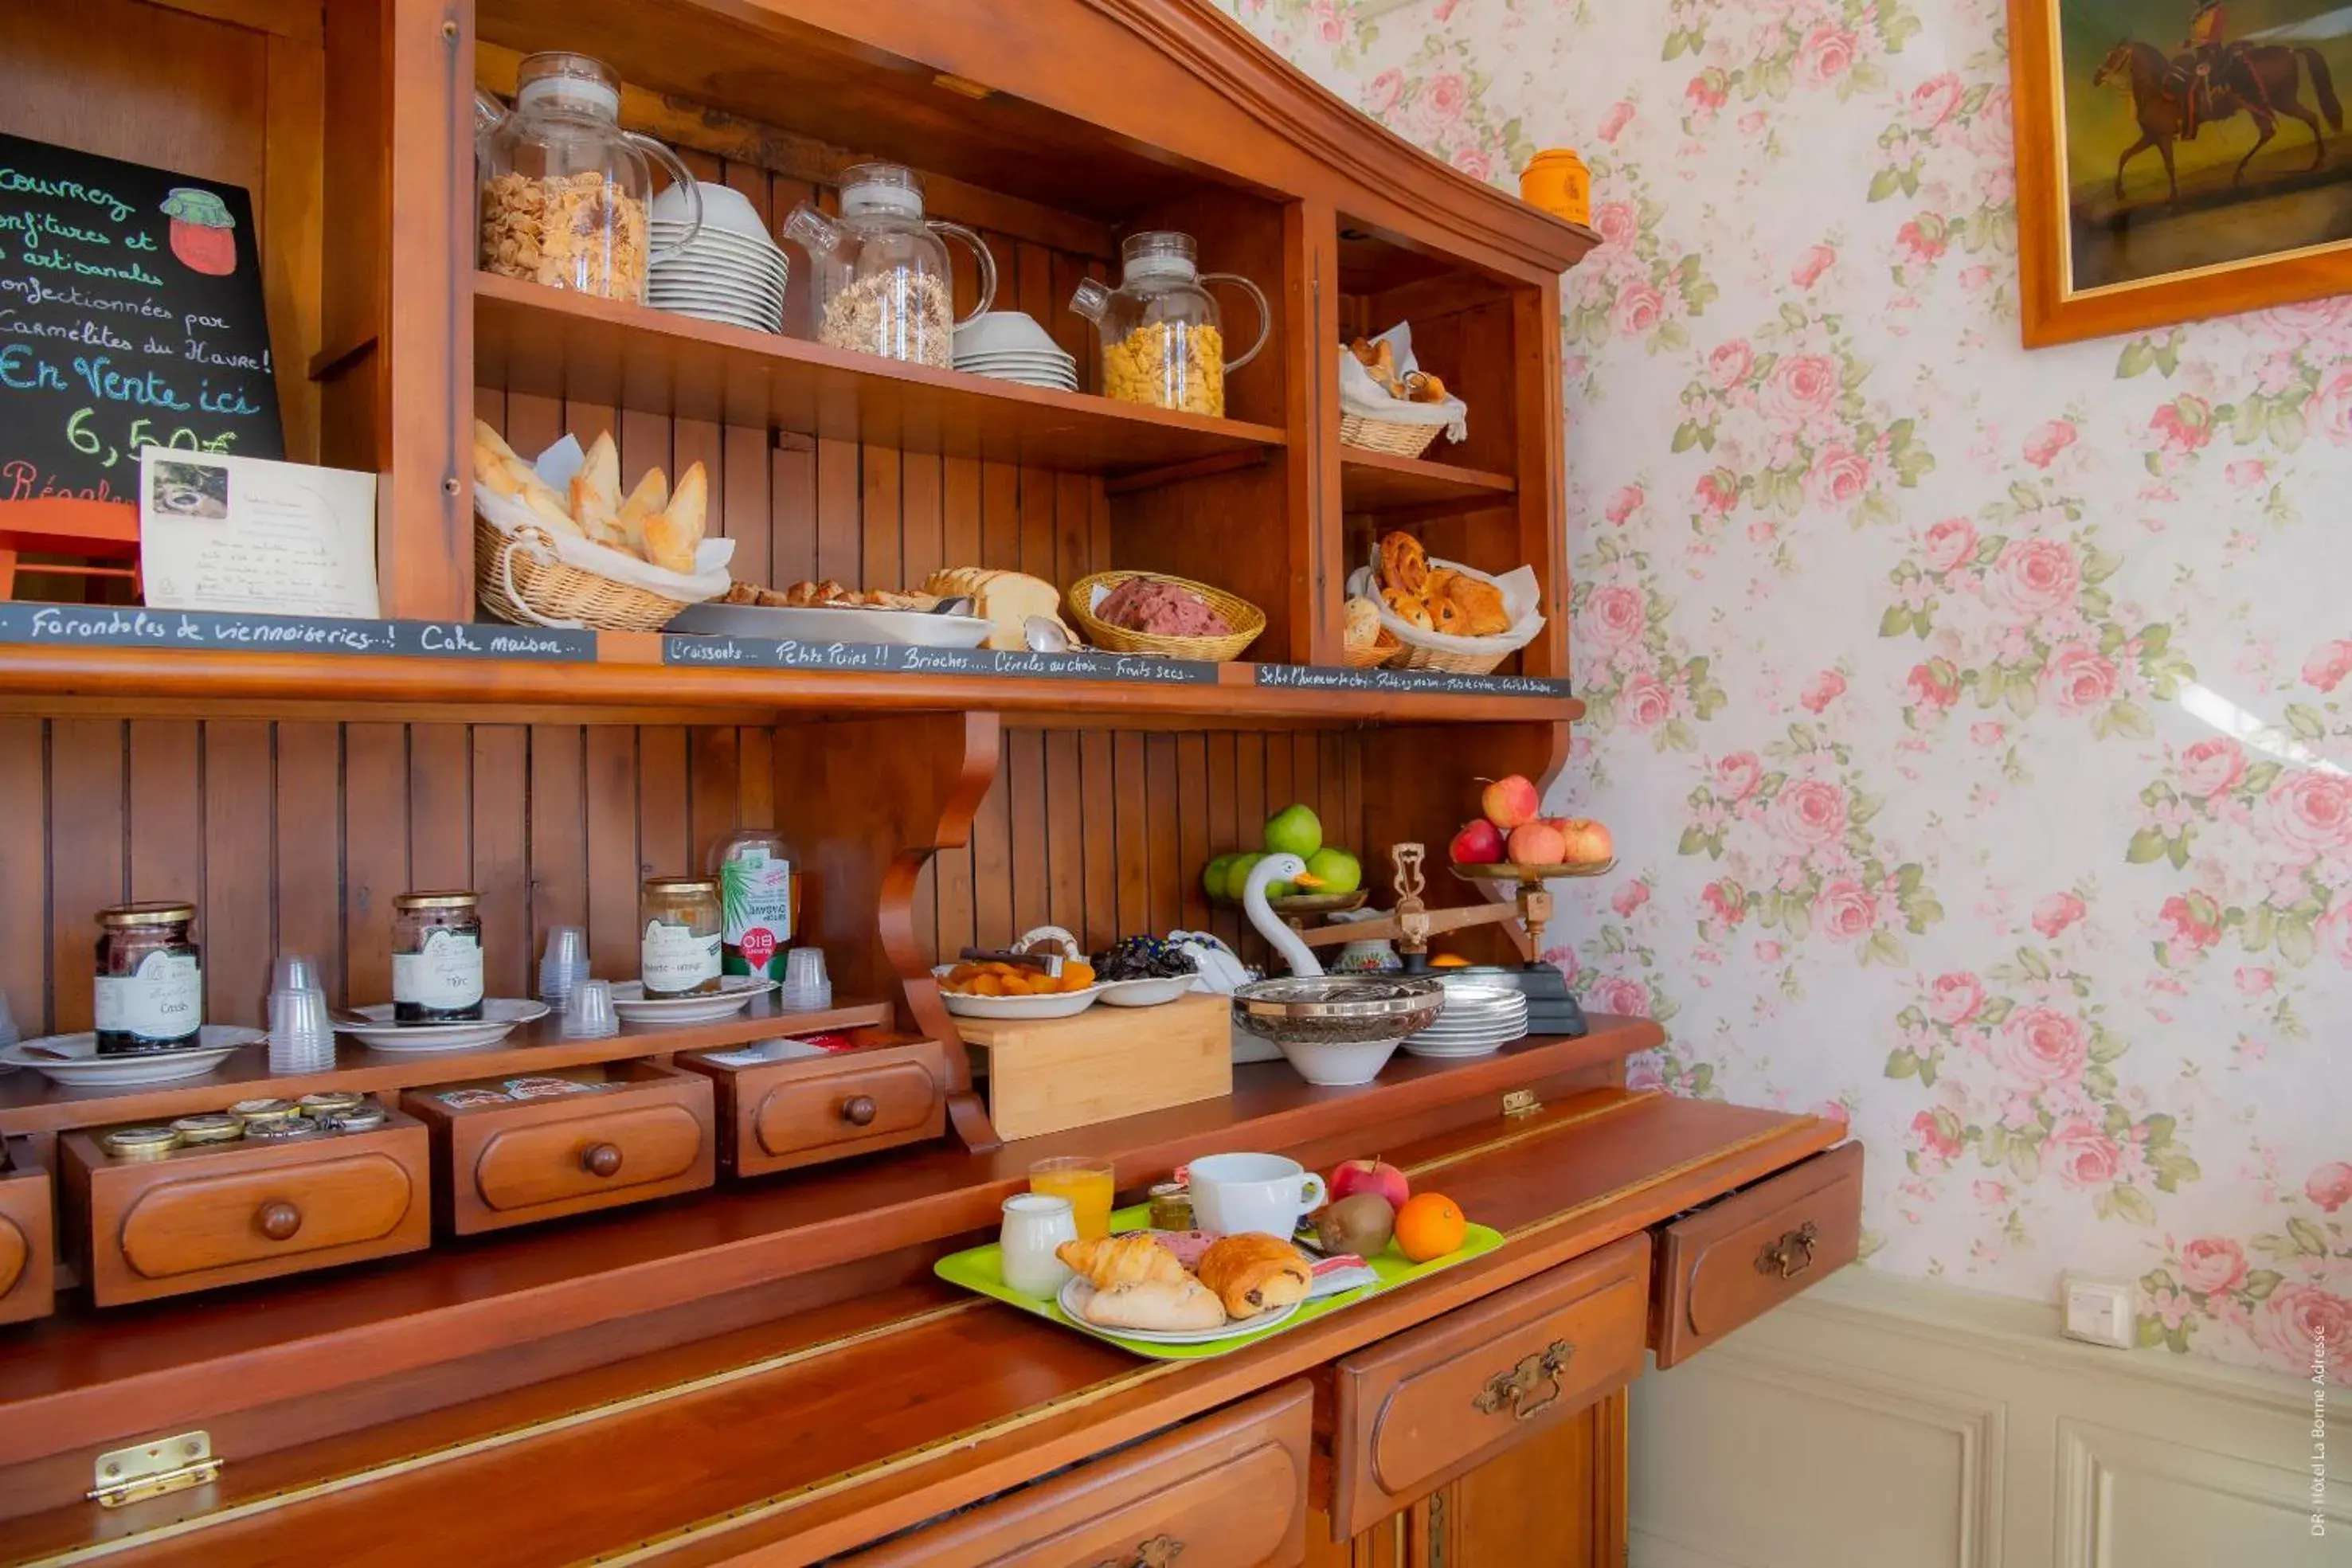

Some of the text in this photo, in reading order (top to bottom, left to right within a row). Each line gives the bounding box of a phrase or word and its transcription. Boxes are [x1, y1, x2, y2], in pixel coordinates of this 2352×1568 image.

[125, 231, 158, 251] et
[23, 248, 163, 286] artisanales
[185, 313, 230, 336] par
[143, 337, 174, 354] du
[0, 343, 260, 414] En Vente ici
[31, 608, 166, 637] Farandoles
[177, 614, 204, 640] de
[421, 624, 482, 651] Cake
[1050, 661, 1066, 672] au
[1116, 658, 1151, 677] Fruits
[742, 933, 773, 945] BIO
